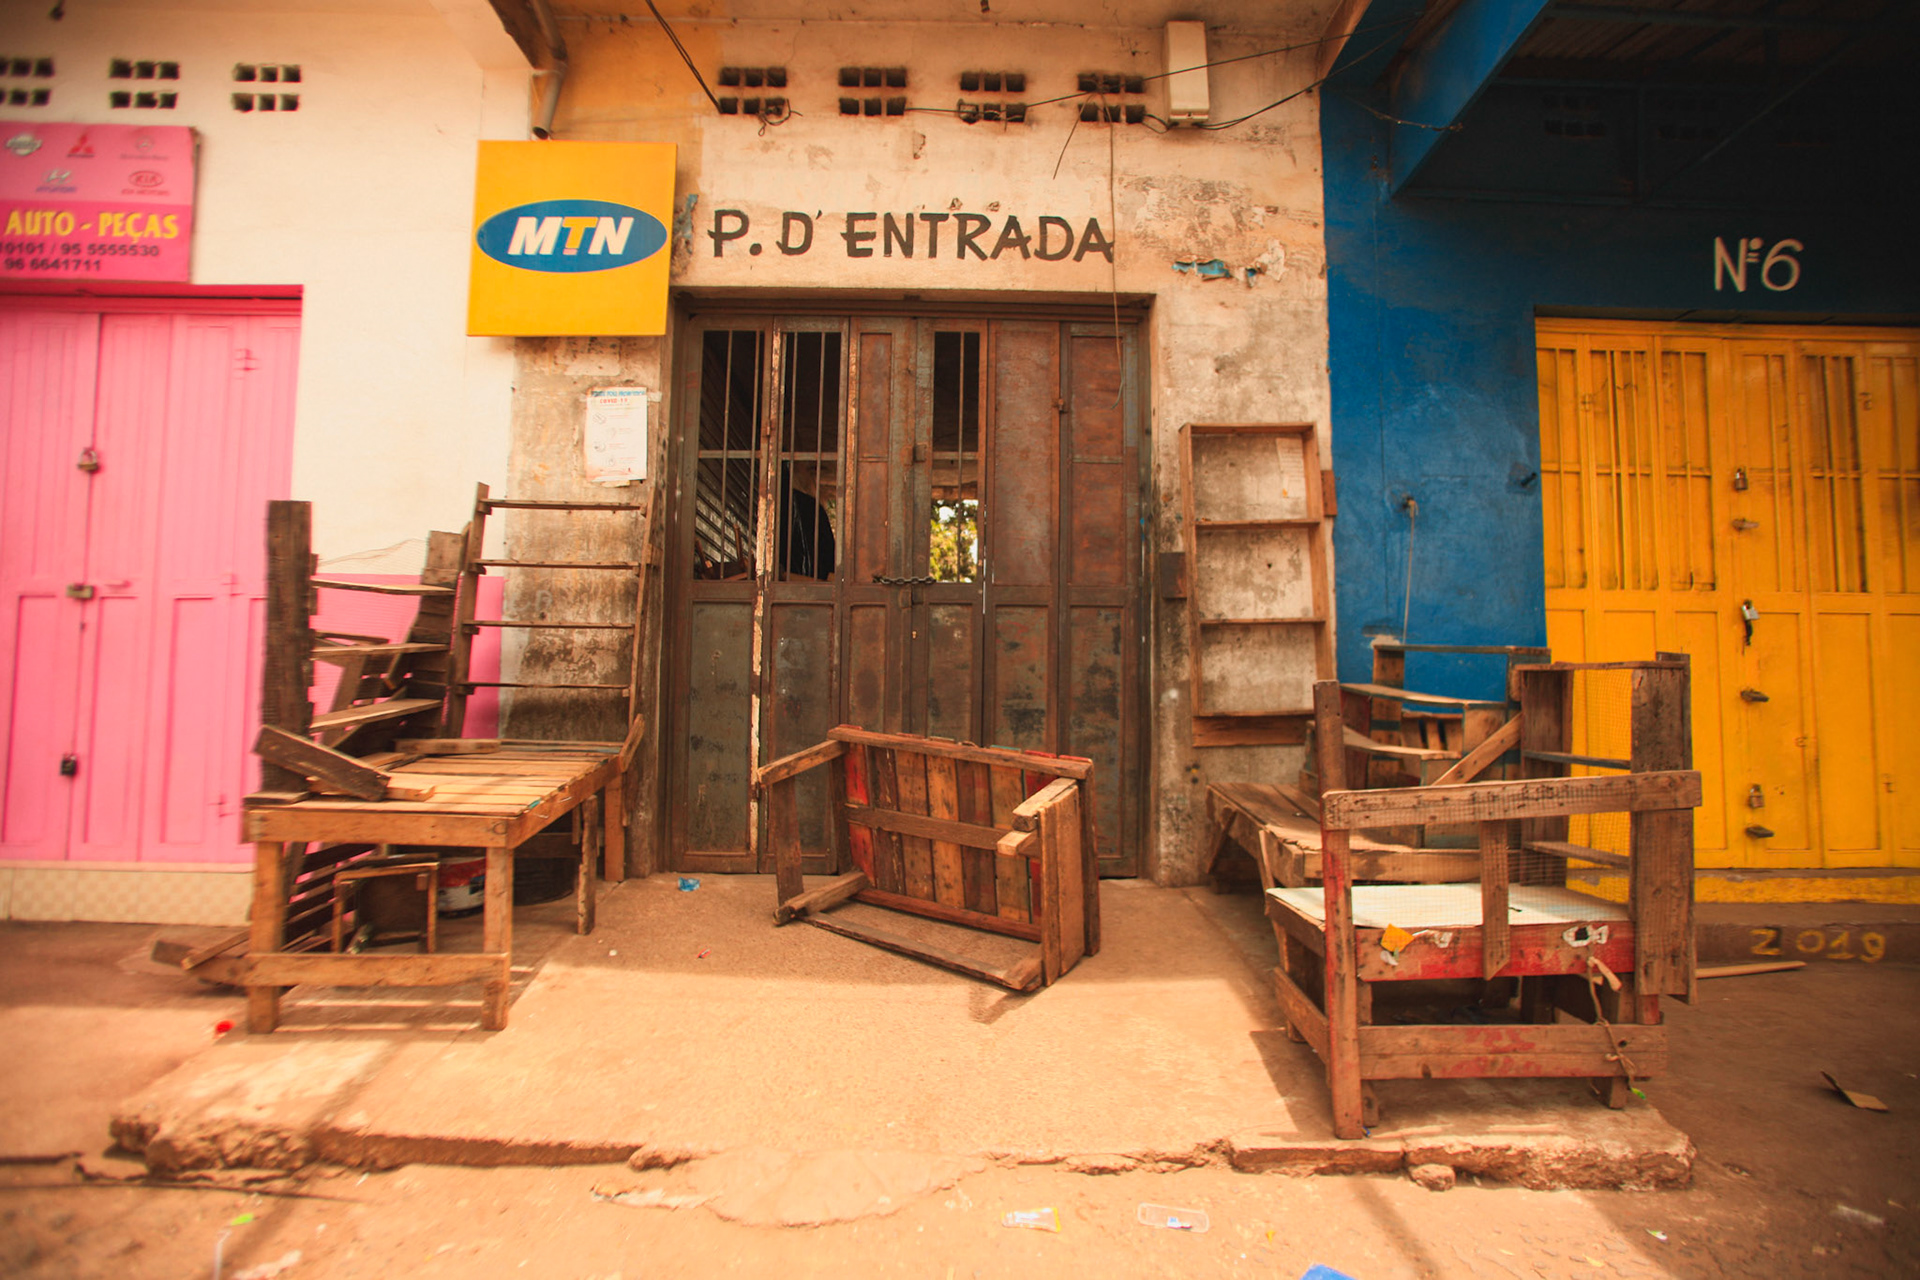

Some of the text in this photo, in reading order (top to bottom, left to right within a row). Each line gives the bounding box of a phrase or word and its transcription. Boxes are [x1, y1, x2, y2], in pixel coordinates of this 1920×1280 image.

[4, 210, 75, 236] AUTO
[98, 211, 179, 244] PEÇAS
[507, 216, 635, 256] MTN
[707, 209, 762, 258] P.
[841, 212, 1116, 264] ENTRADA
[60, 242, 82, 255] 95
[1751, 928, 1887, 963] 2019
